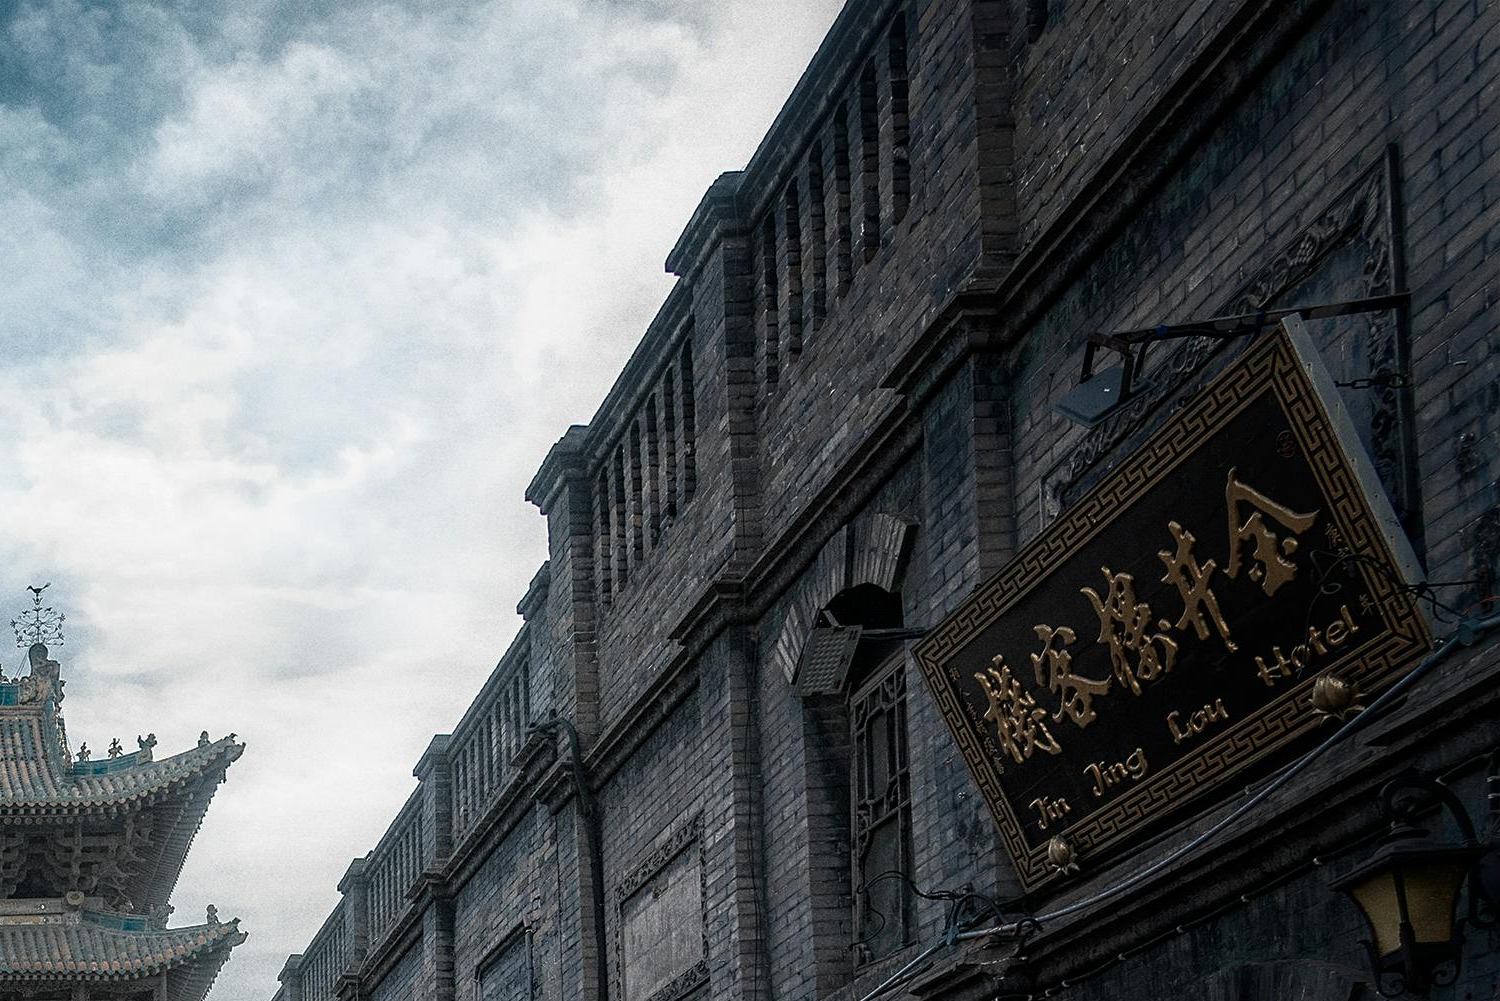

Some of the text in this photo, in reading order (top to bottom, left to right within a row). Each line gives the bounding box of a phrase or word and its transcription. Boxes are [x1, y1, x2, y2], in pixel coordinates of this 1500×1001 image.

[1028, 605, 1360, 830] Jin Jing Lou Hotel
